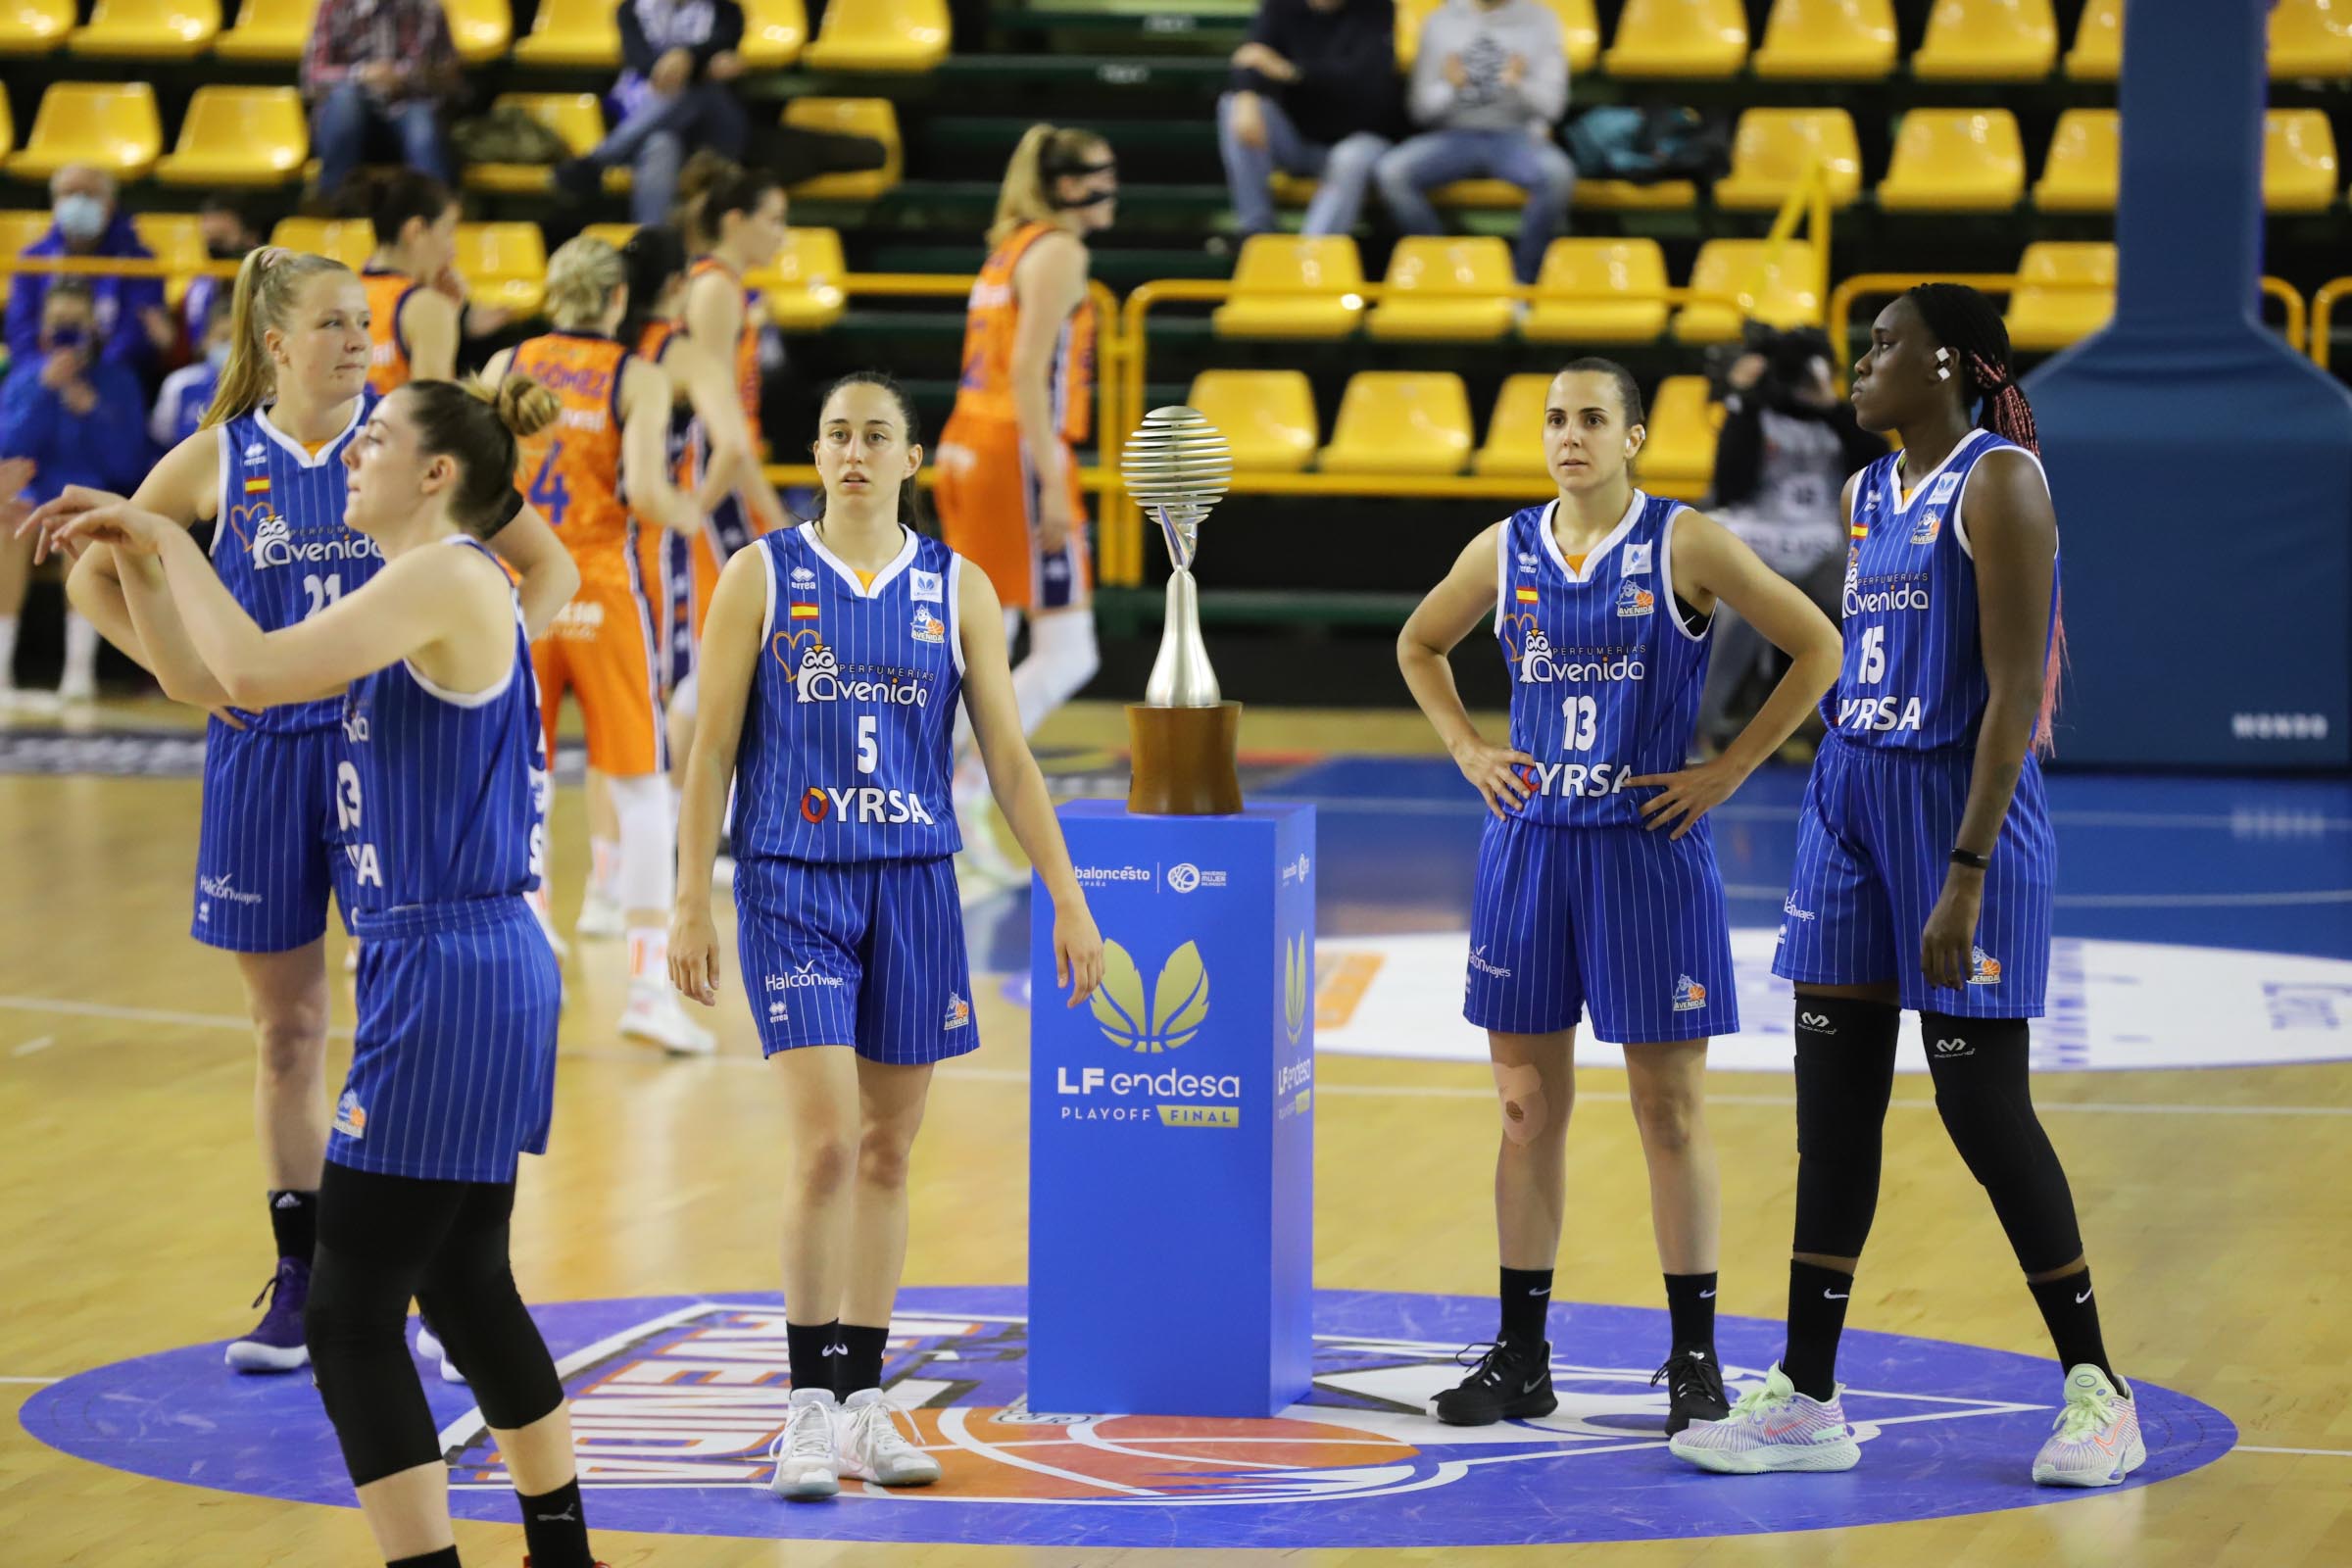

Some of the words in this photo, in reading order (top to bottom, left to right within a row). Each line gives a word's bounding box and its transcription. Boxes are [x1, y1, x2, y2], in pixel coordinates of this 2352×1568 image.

[528, 439, 570, 525] 4
[1857, 624, 1886, 685] 15
[1561, 695, 1597, 752] 13
[1838, 696, 1921, 731] YRSA
[857, 715, 878, 774] 5
[1056, 1066, 1104, 1095] LF
[1110, 1067, 1241, 1099] endesa
[1061, 1107, 1152, 1122] PLAYOFF
[1170, 1108, 1232, 1123] FINAL
